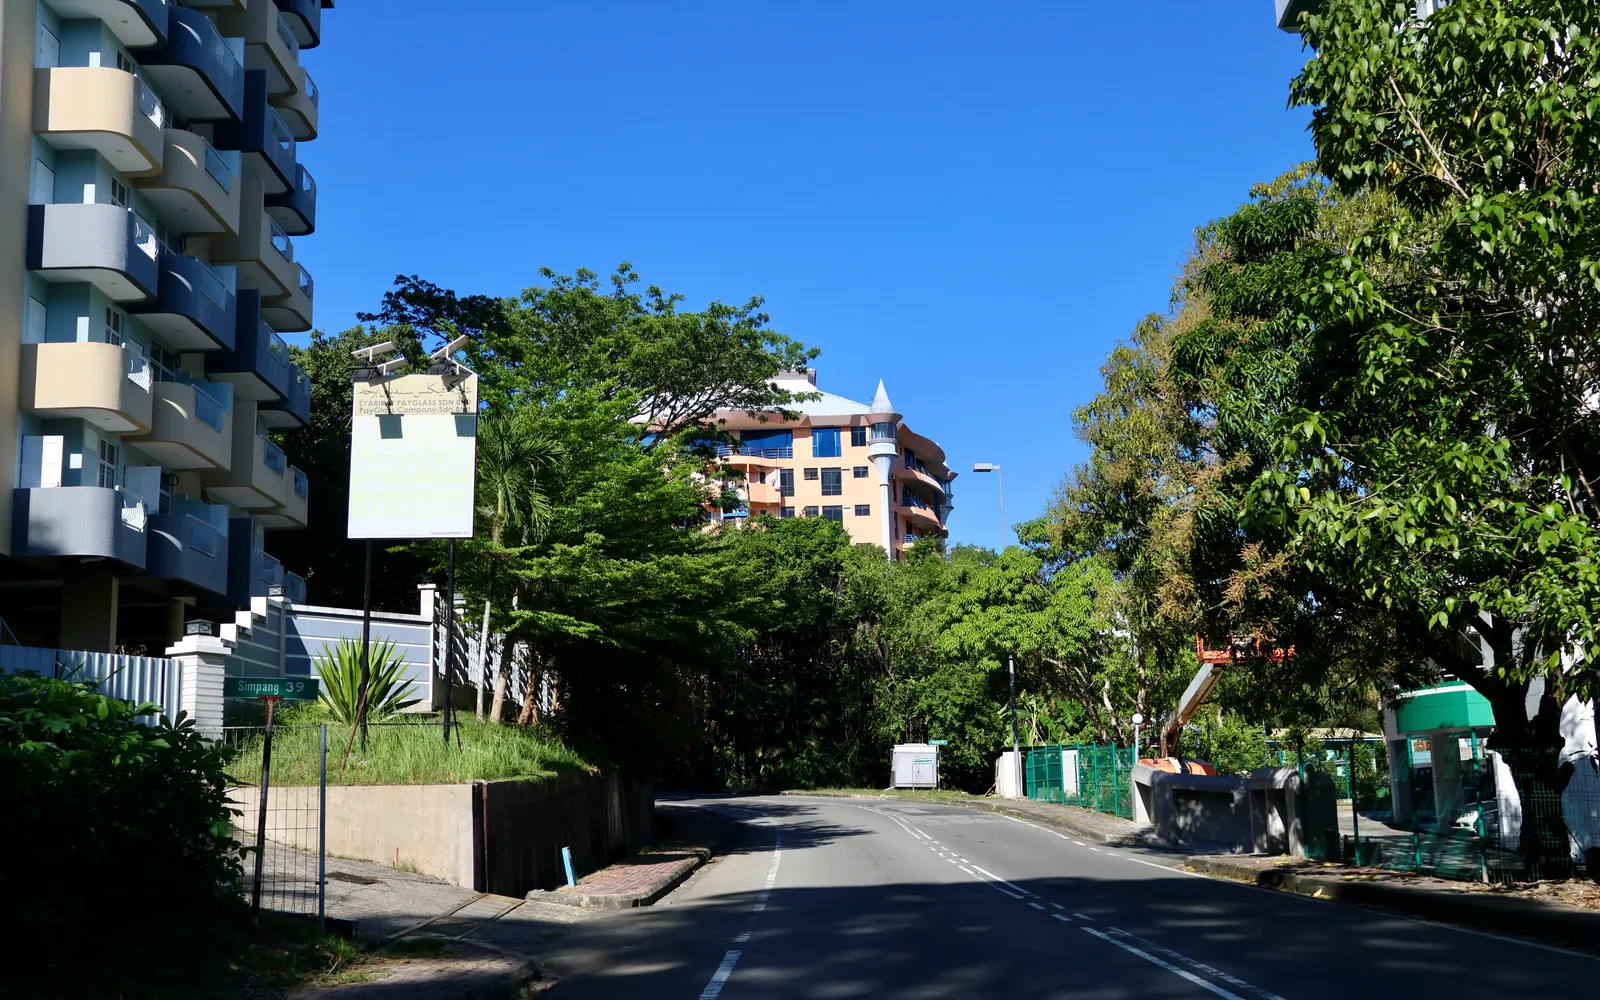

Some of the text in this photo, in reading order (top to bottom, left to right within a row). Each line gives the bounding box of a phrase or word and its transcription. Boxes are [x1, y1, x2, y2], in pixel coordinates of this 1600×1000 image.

[397, 406, 437, 414] Company
[238, 680, 304, 695] Simpang 39
